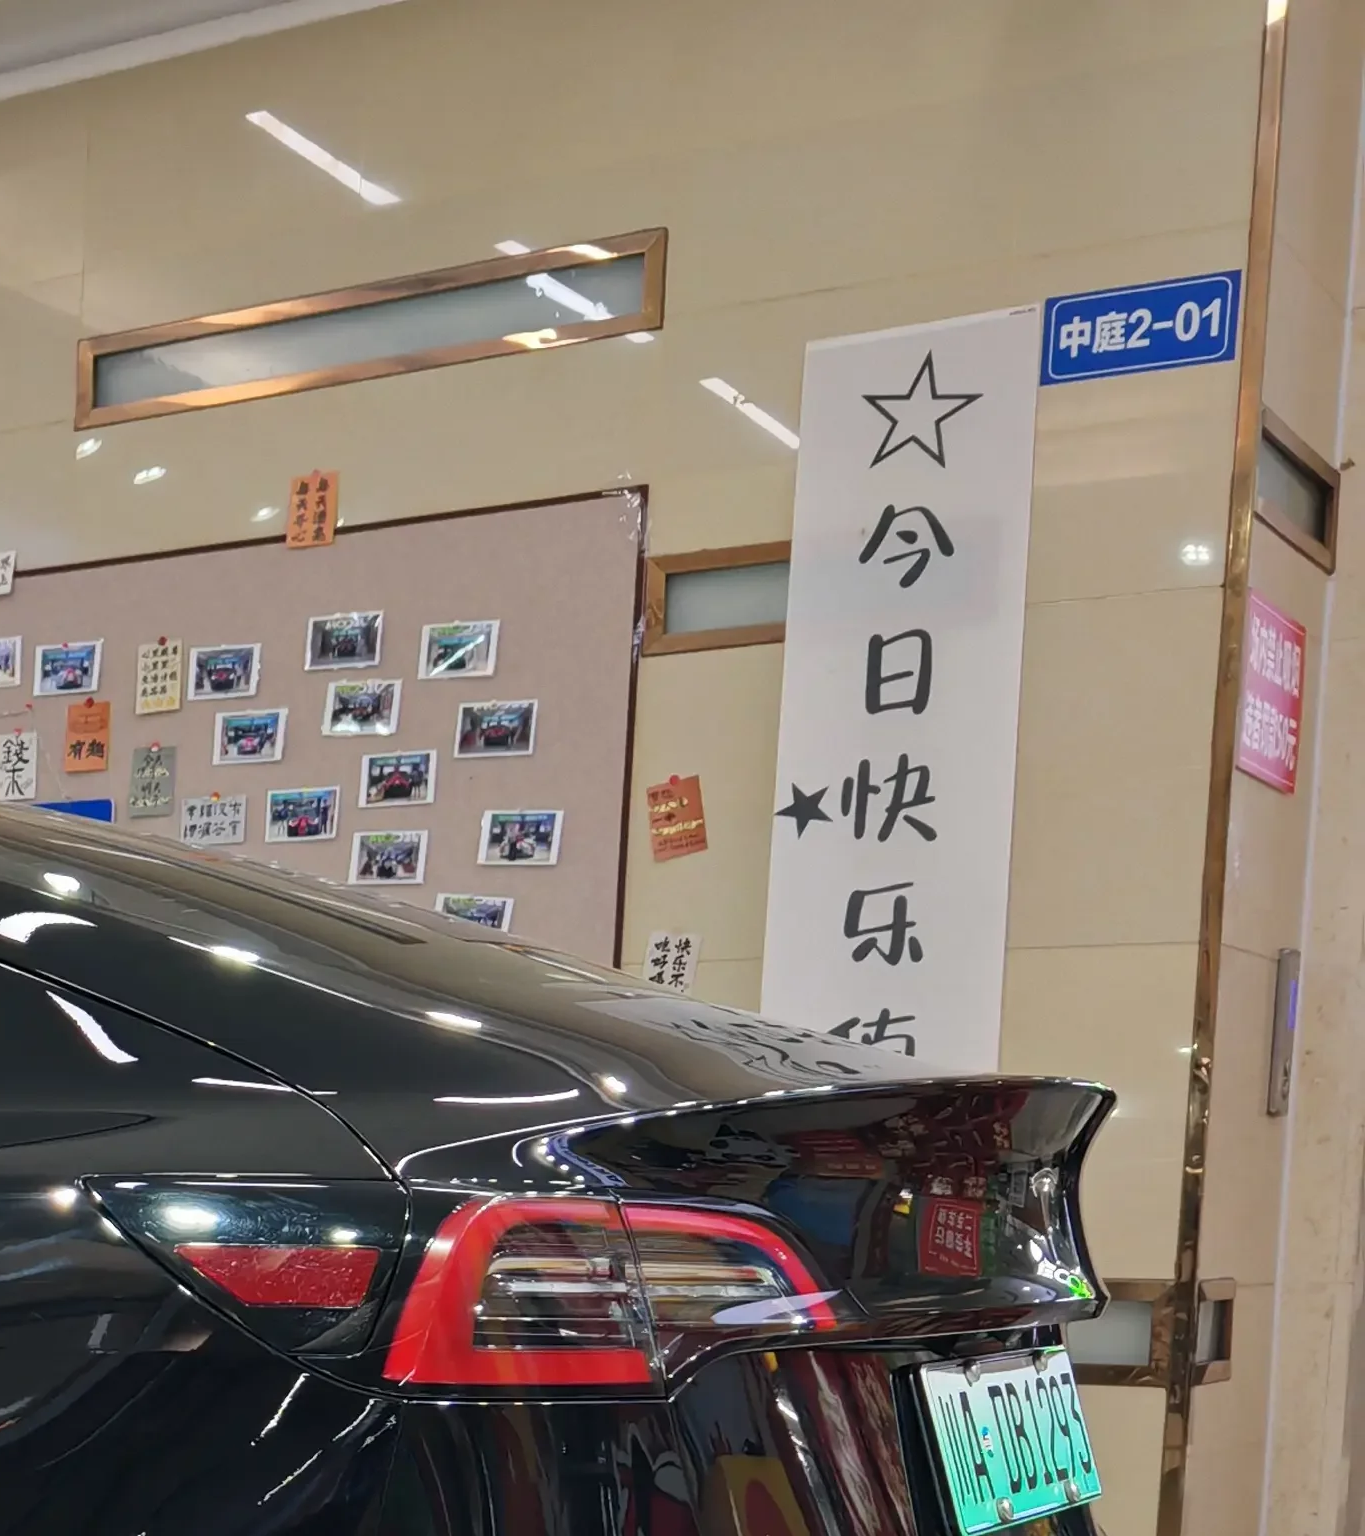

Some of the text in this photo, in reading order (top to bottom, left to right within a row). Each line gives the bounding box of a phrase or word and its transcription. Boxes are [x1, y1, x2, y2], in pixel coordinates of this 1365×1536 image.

[1058, 297, 1223, 359] 中庭2-01
[668, 937, 692, 993] 快乐不
